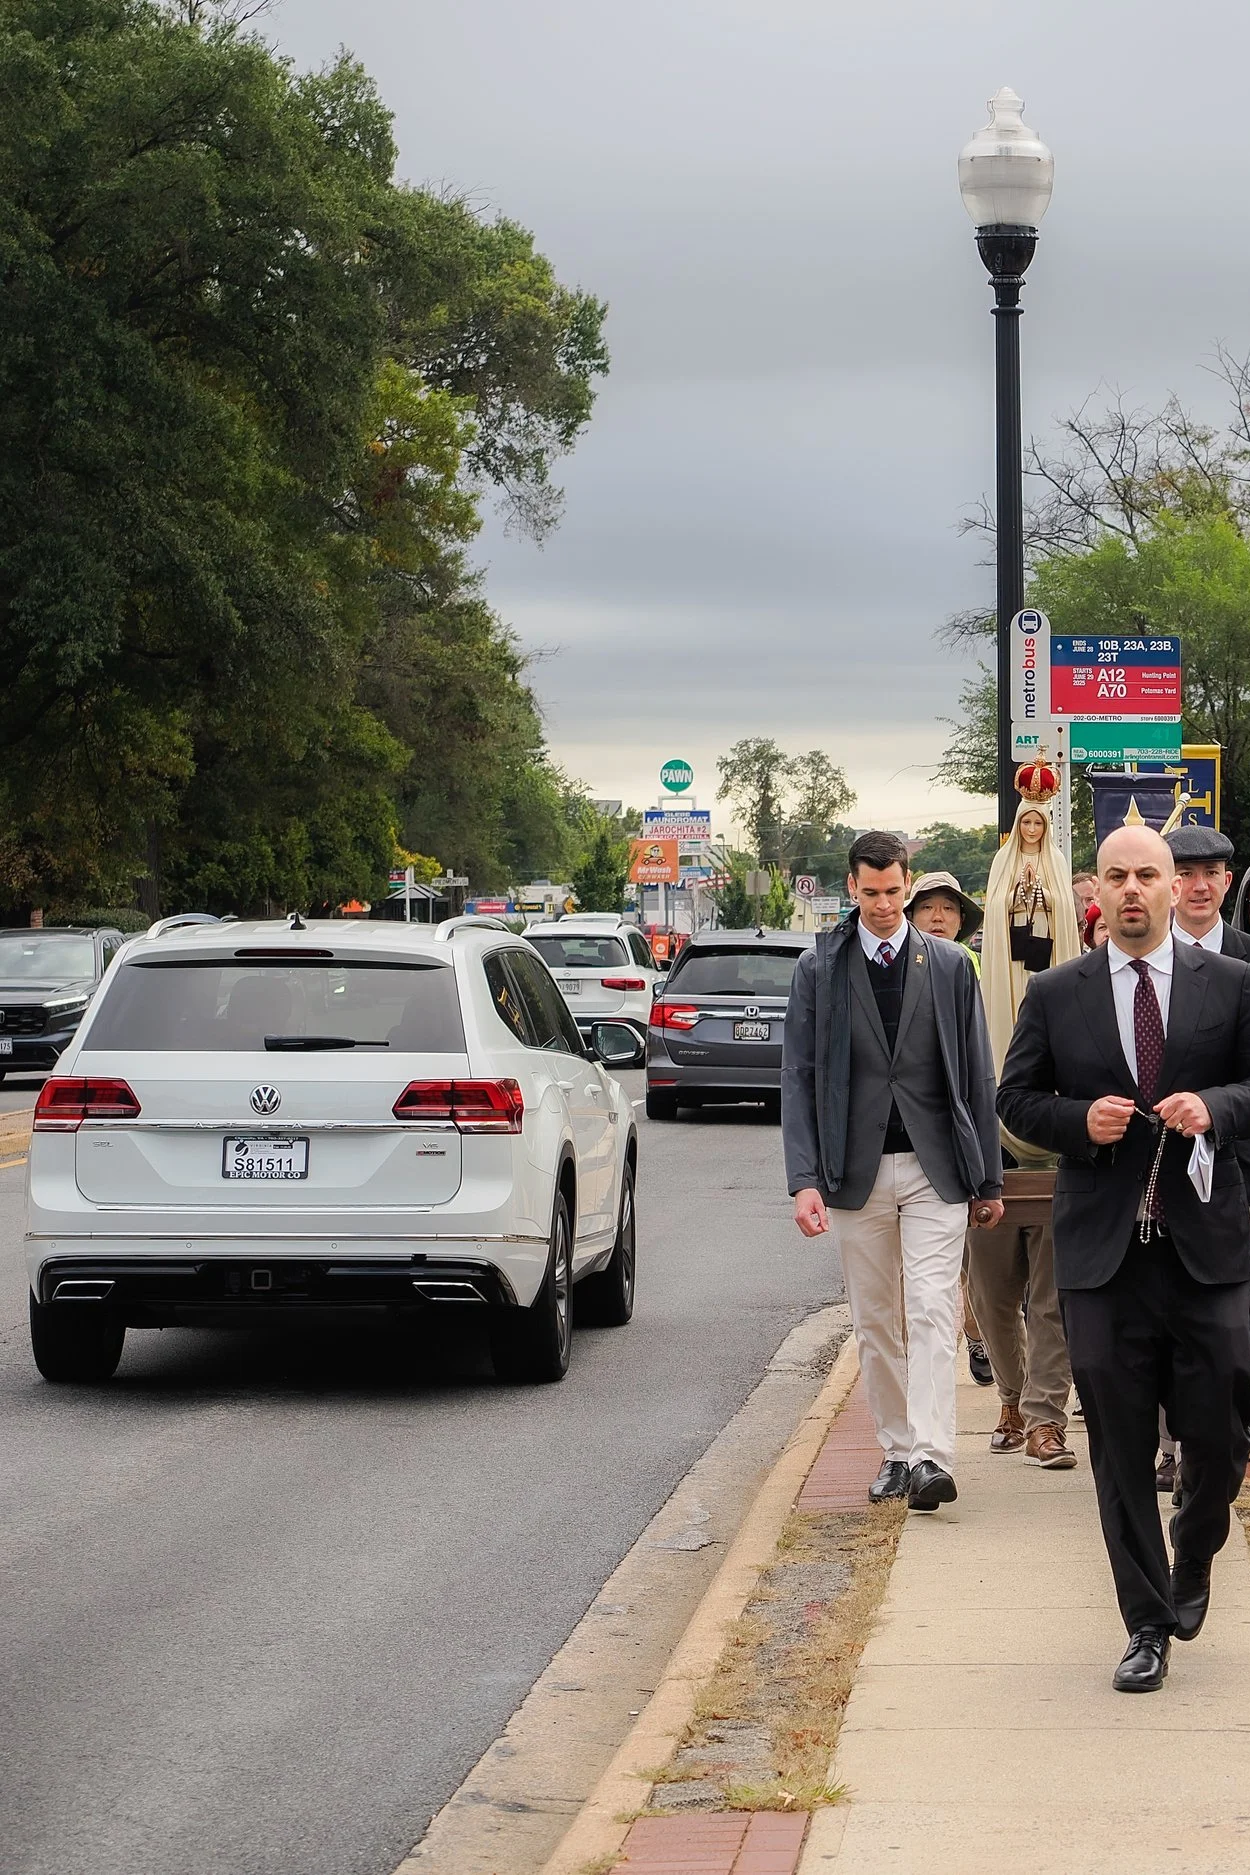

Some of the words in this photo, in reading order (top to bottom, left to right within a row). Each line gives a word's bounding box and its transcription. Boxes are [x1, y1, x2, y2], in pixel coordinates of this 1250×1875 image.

[1098, 640, 1122, 651] 10B,
[1124, 641, 1148, 652] 23A,
[1150, 641, 1174, 652] 23B,
[1098, 653, 1118, 662] 23T
[1022, 638, 1036, 718] metrobus
[1097, 668, 1125, 681] A12
[1097, 684, 1127, 697] A70
[1016, 736, 1039, 744] ART
[662, 770, 692, 782] PAWN
[1188, 779, 1199, 792] L
[194, 1120, 334, 1128] ATLAS
[234, 1158, 293, 1171] S81511
